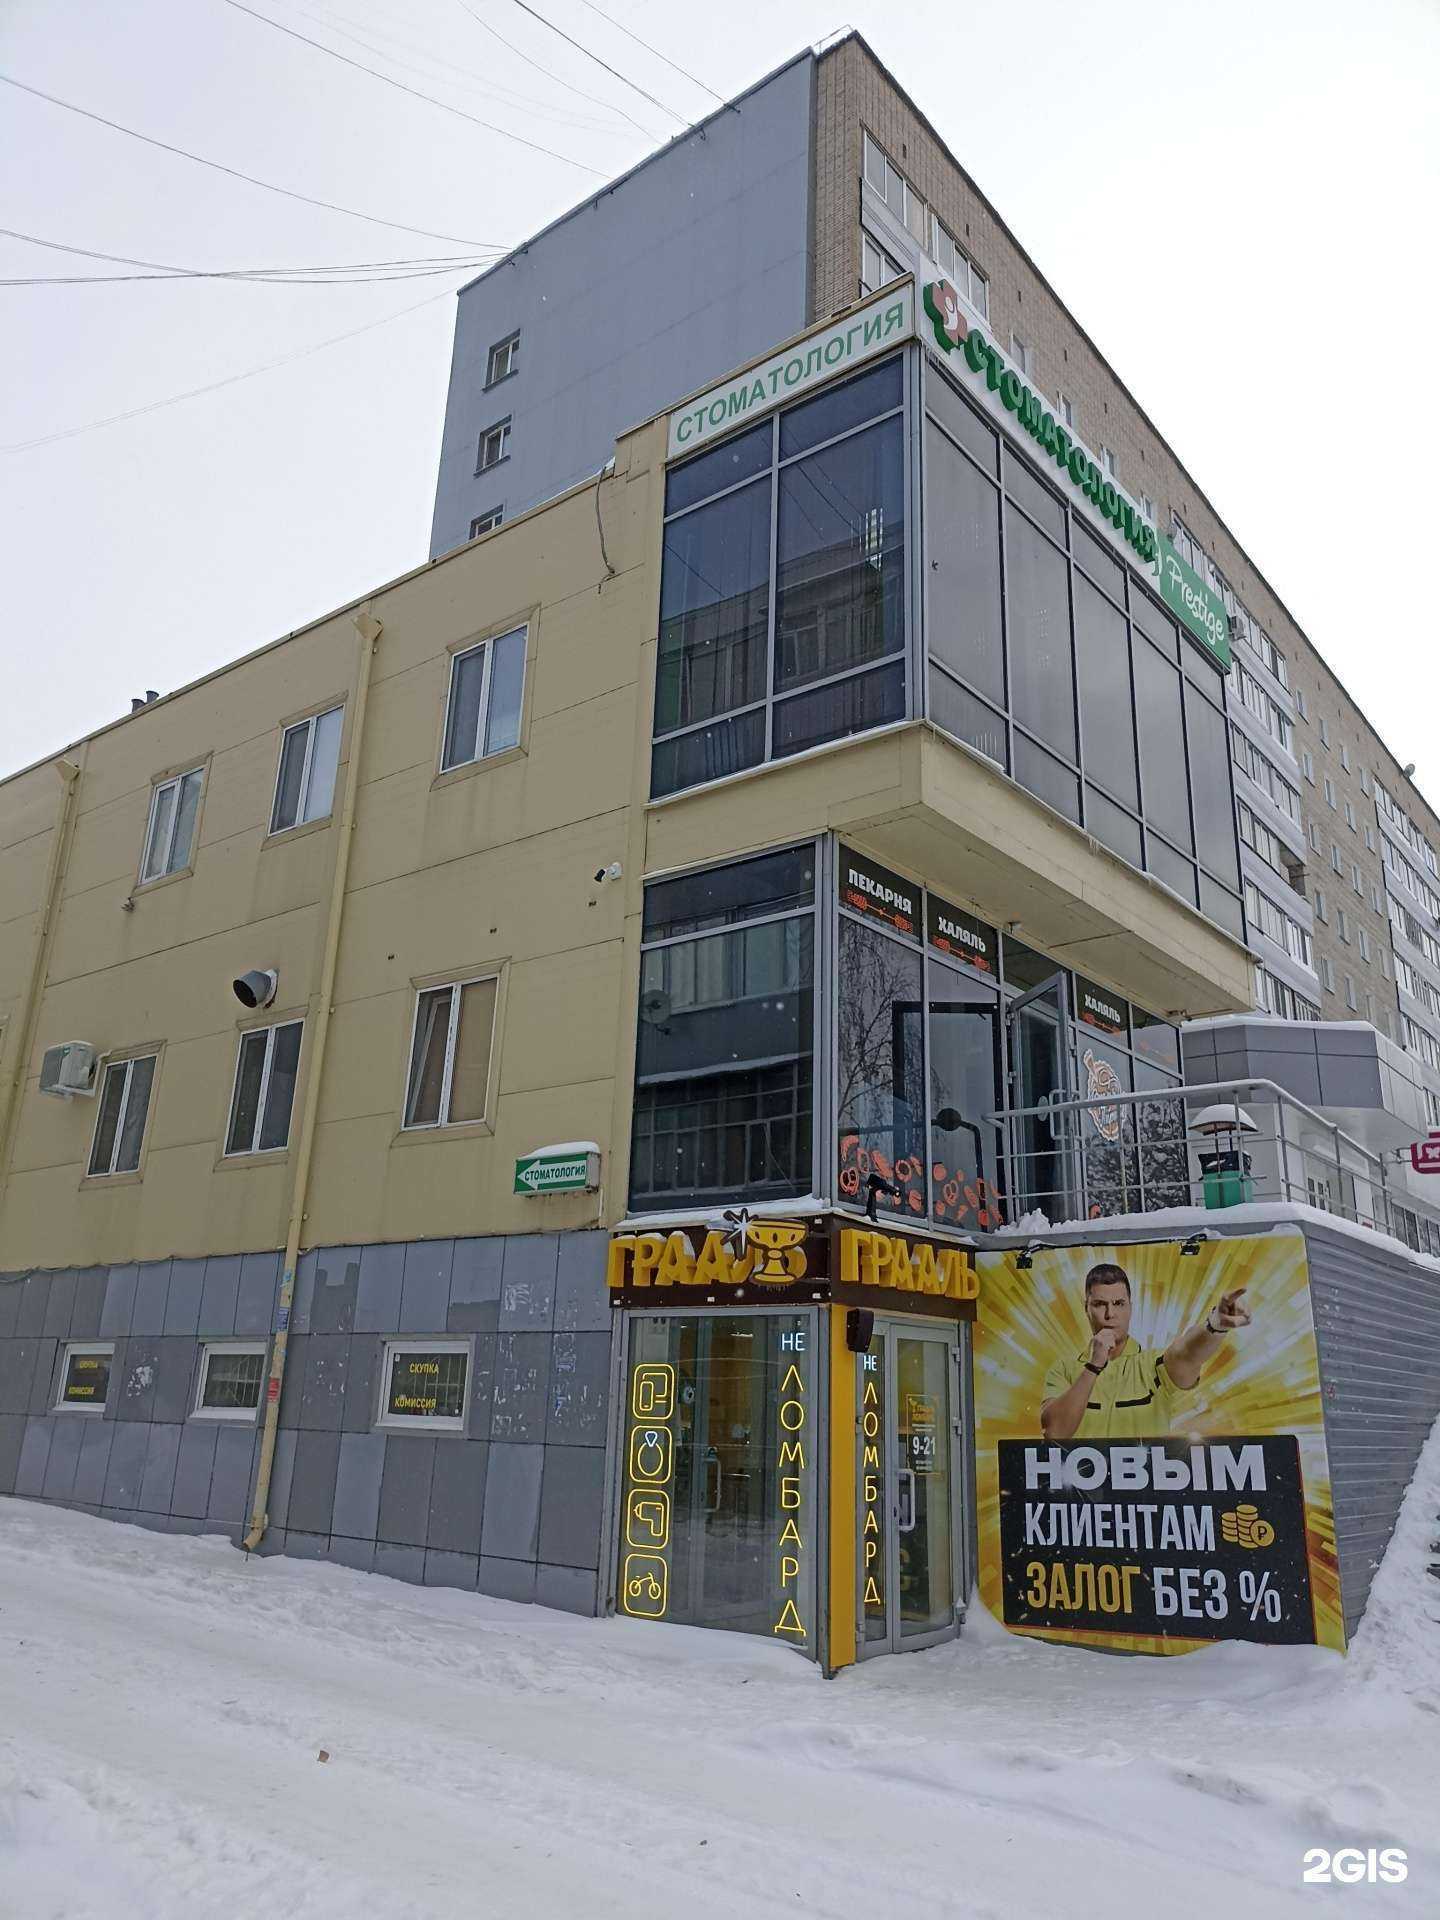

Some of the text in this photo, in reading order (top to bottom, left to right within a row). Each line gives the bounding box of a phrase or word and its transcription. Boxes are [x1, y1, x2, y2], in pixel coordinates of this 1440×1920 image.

[676, 302, 904, 443] СТОМАТОЛОГИЯ
[964, 328, 1157, 563] СТОМАТОЛОГИЯ
[1165, 554, 1225, 646] Prestige
[848, 868, 912, 914] ПЕКАРНЯ
[938, 916, 987, 953] ХАЛЯЛЬ
[1084, 993, 1121, 1024] ХАЛЯЛЬ
[524, 1165, 586, 1181] СТОМАТОЛОГИЯ
[840, 1228, 980, 1300] ГРААЛЬ
[409, 1363, 439, 1374] СКУПКА
[394, 1397, 437, 1409] КОМИССИЯ
[912, 1436, 936, 1456] 9-21
[1024, 1445, 1267, 1492] НОВЫМ
[774, 1332, 807, 1637] НЕ ЛОМБАРД
[863, 1354, 881, 1605] НЕ ЛОМБАРД
[1024, 1502, 1216, 1552] КЛИЕНТАМ
[1026, 1561, 1283, 1623] ЗАЛОГ БЕЗ %
